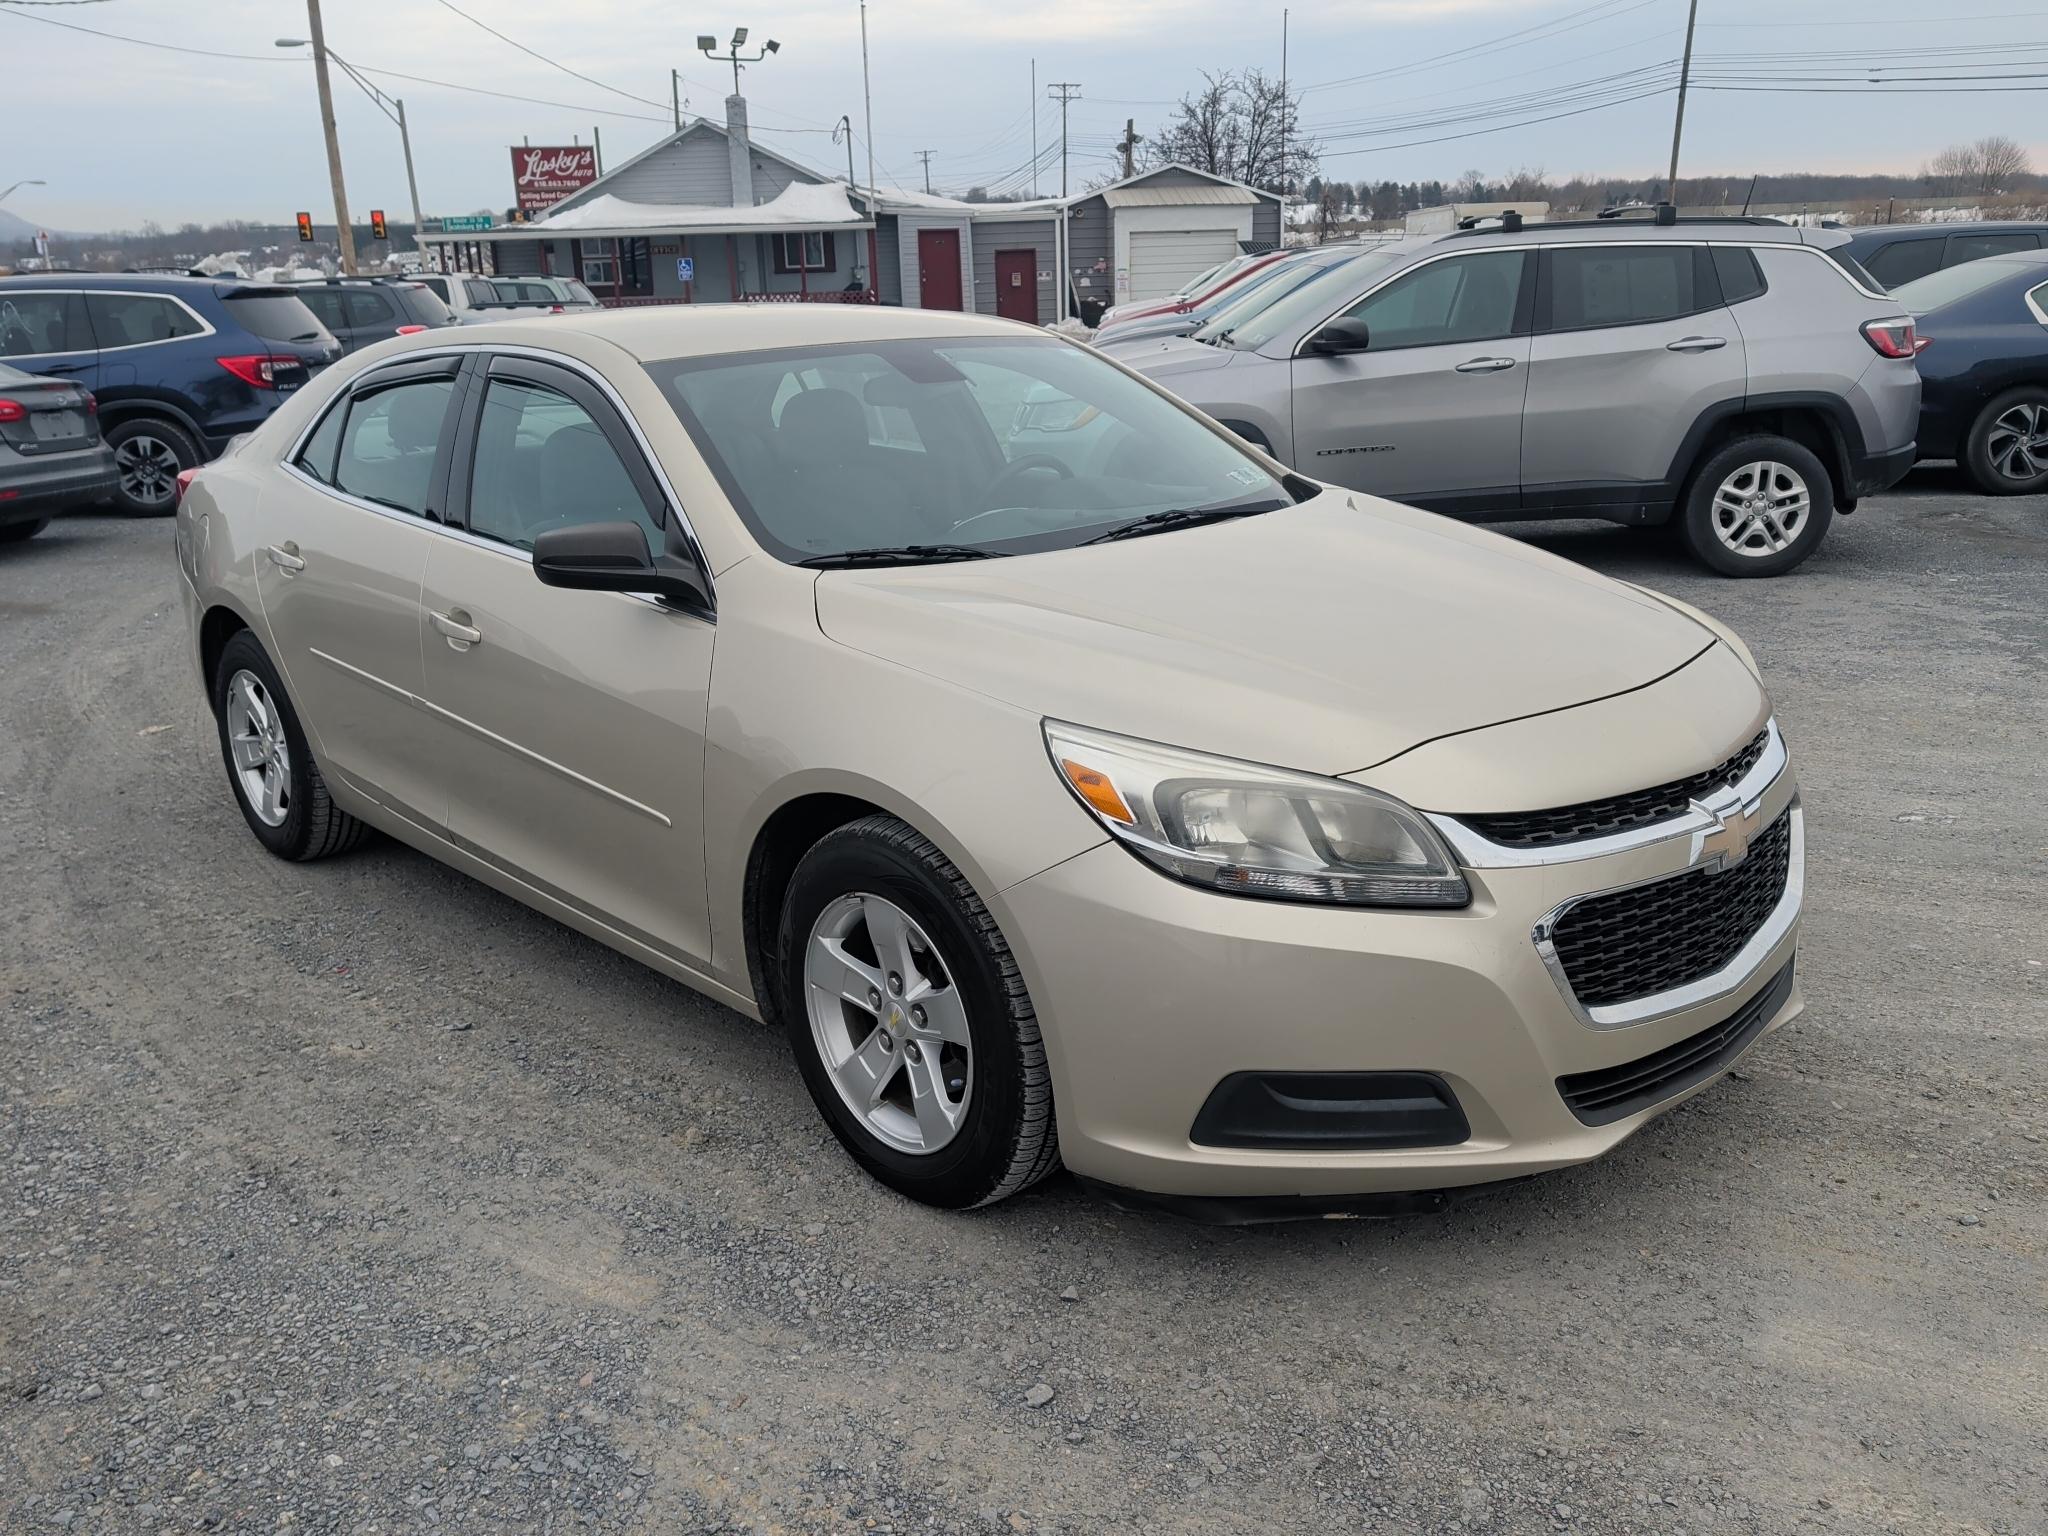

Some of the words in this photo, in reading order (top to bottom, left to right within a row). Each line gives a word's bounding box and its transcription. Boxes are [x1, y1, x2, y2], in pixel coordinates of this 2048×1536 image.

[572, 168, 593, 177] AUTO
[519, 191, 541, 200] Selling
[540, 191, 557, 199] Good
[532, 200, 548, 208] Good
[1316, 445, 1396, 456] COMPASS
